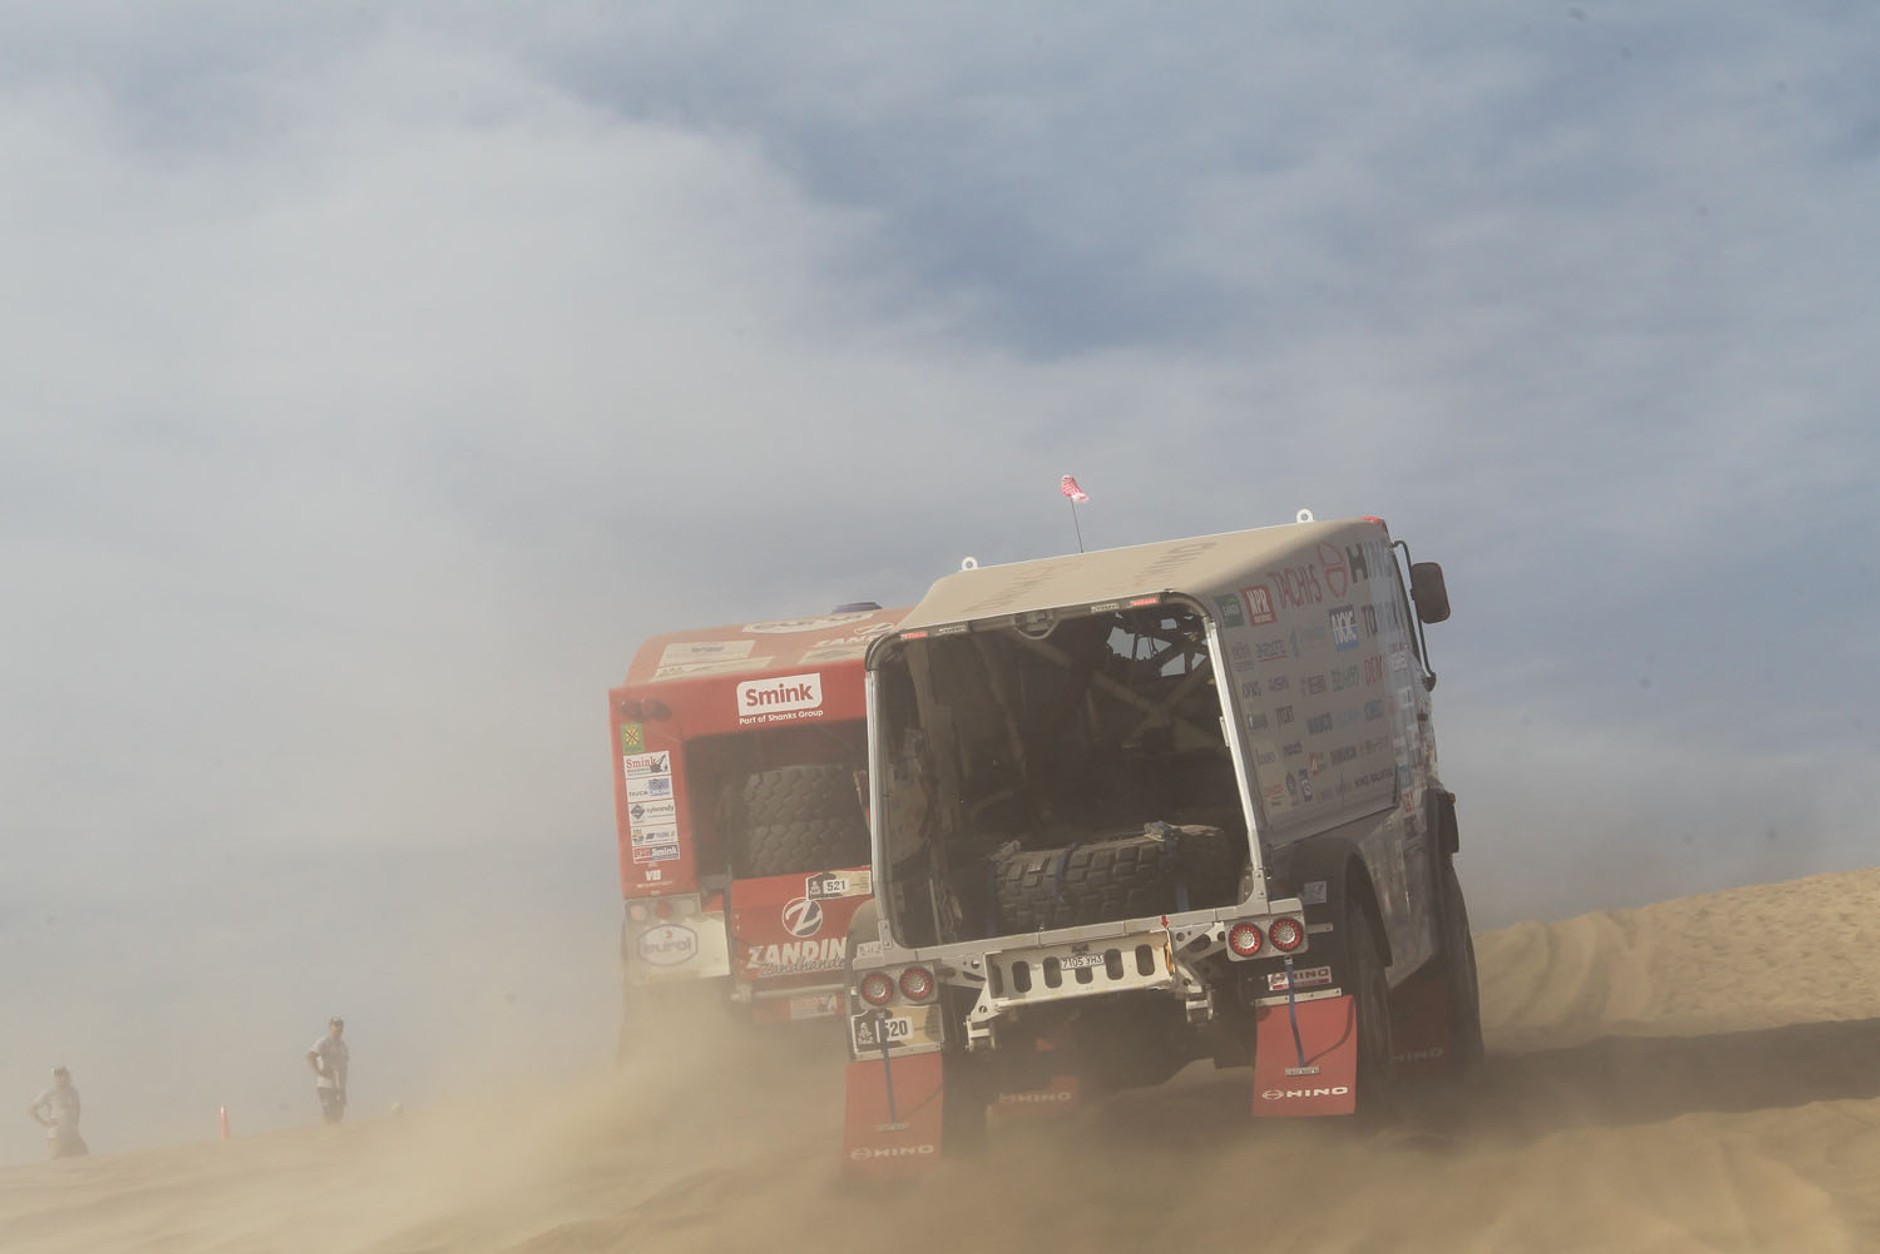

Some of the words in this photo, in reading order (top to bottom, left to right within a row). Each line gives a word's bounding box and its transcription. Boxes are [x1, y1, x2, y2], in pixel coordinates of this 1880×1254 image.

[1245, 588, 1271, 615] NPR
[745, 683, 813, 707] Smink
[739, 716, 757, 726] Part
[757, 714, 767, 723] of
[768, 712, 798, 722] Shanks
[798, 710, 824, 719] Group
[625, 755, 657, 769] Smink
[826, 880, 847, 892] 521
[1286, 1086, 1349, 1098] HINO
[873, 1144, 934, 1158] HINO
